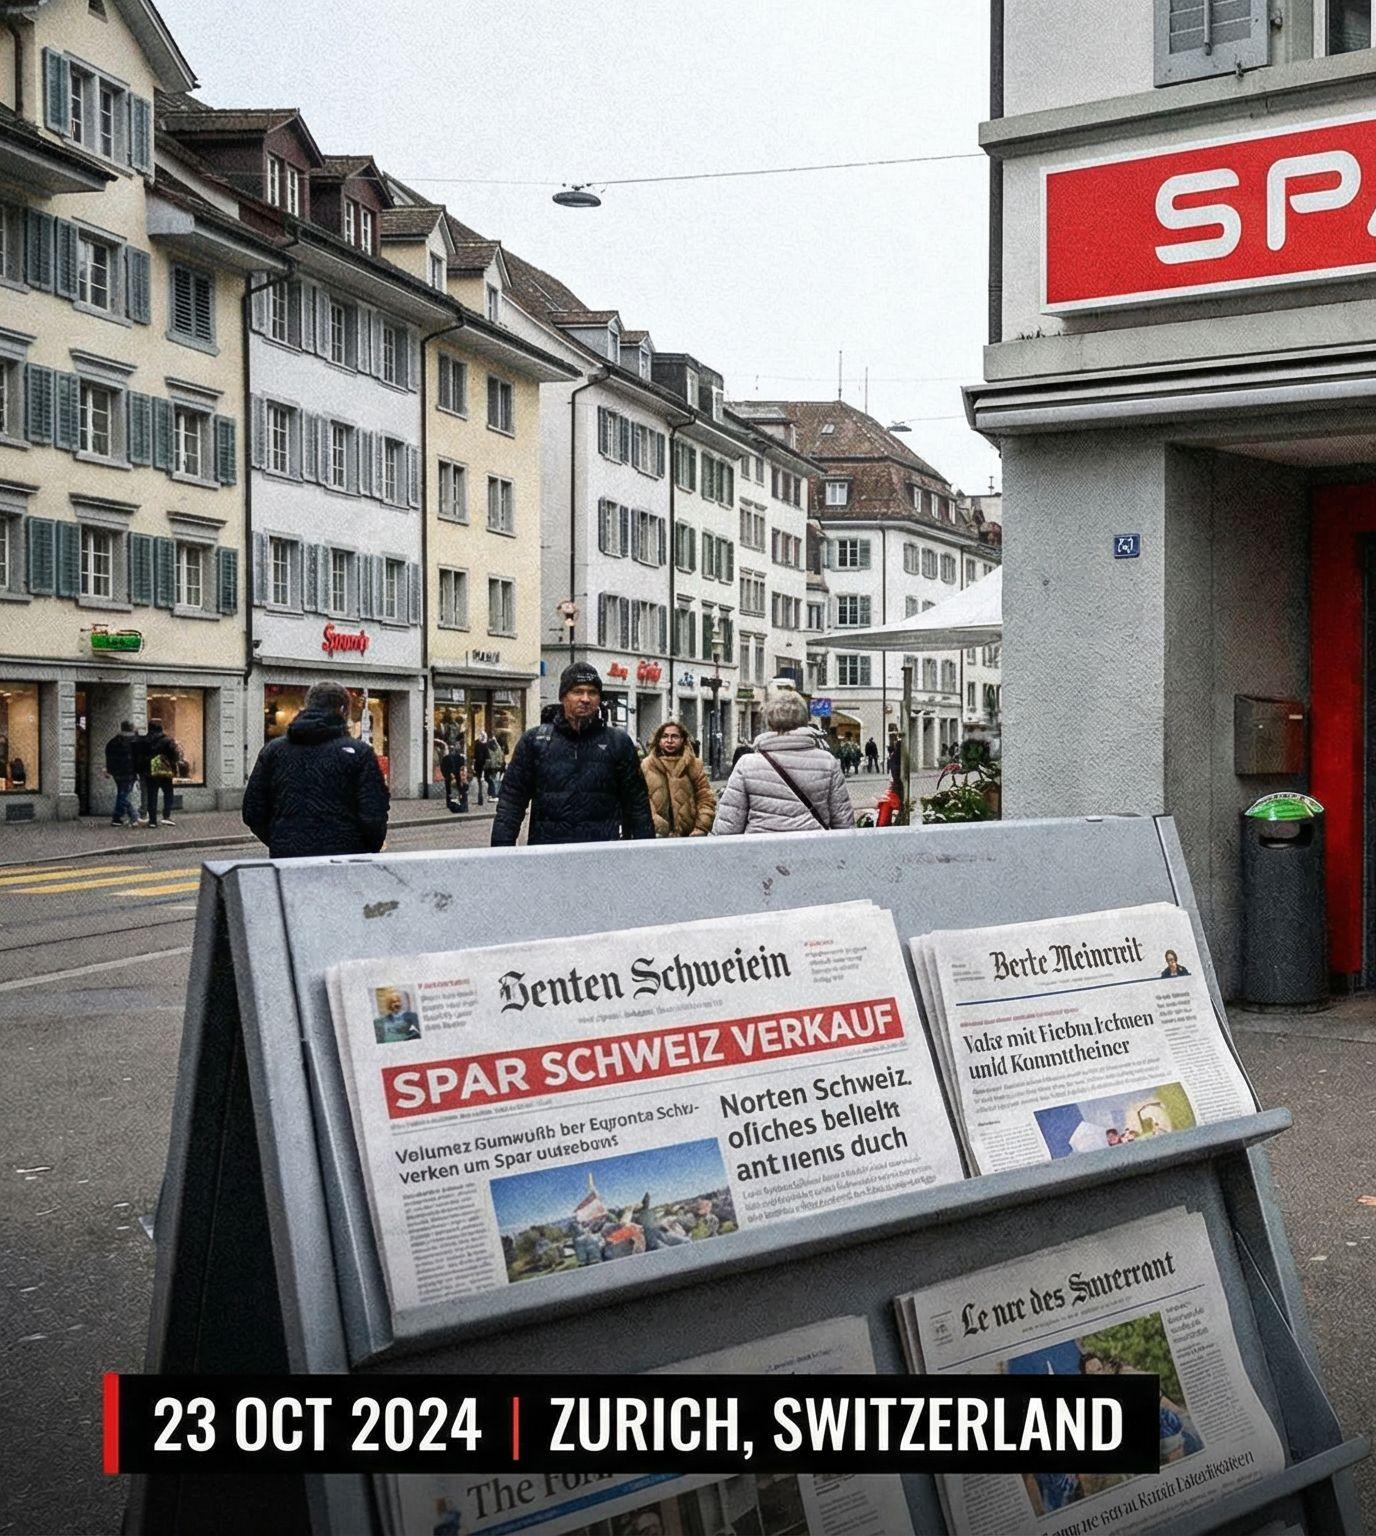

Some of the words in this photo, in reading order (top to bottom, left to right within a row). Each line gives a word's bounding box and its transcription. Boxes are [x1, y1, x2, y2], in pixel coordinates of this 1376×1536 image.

[392, 1057, 531, 1109] SPAR
[541, 1029, 725, 1087] SCHWEIZ
[730, 1003, 893, 1057] VERKAUF
[719, 1086, 808, 1119] Norten
[560, 1122, 586, 1137] ber
[850, 1126, 909, 1157] duch
[464, 1159, 490, 1174] um
[494, 1150, 533, 1170] Spar
[961, 1302, 989, 1338] Le
[1029, 1287, 1066, 1314] des
[466, 1477, 536, 1521] The
